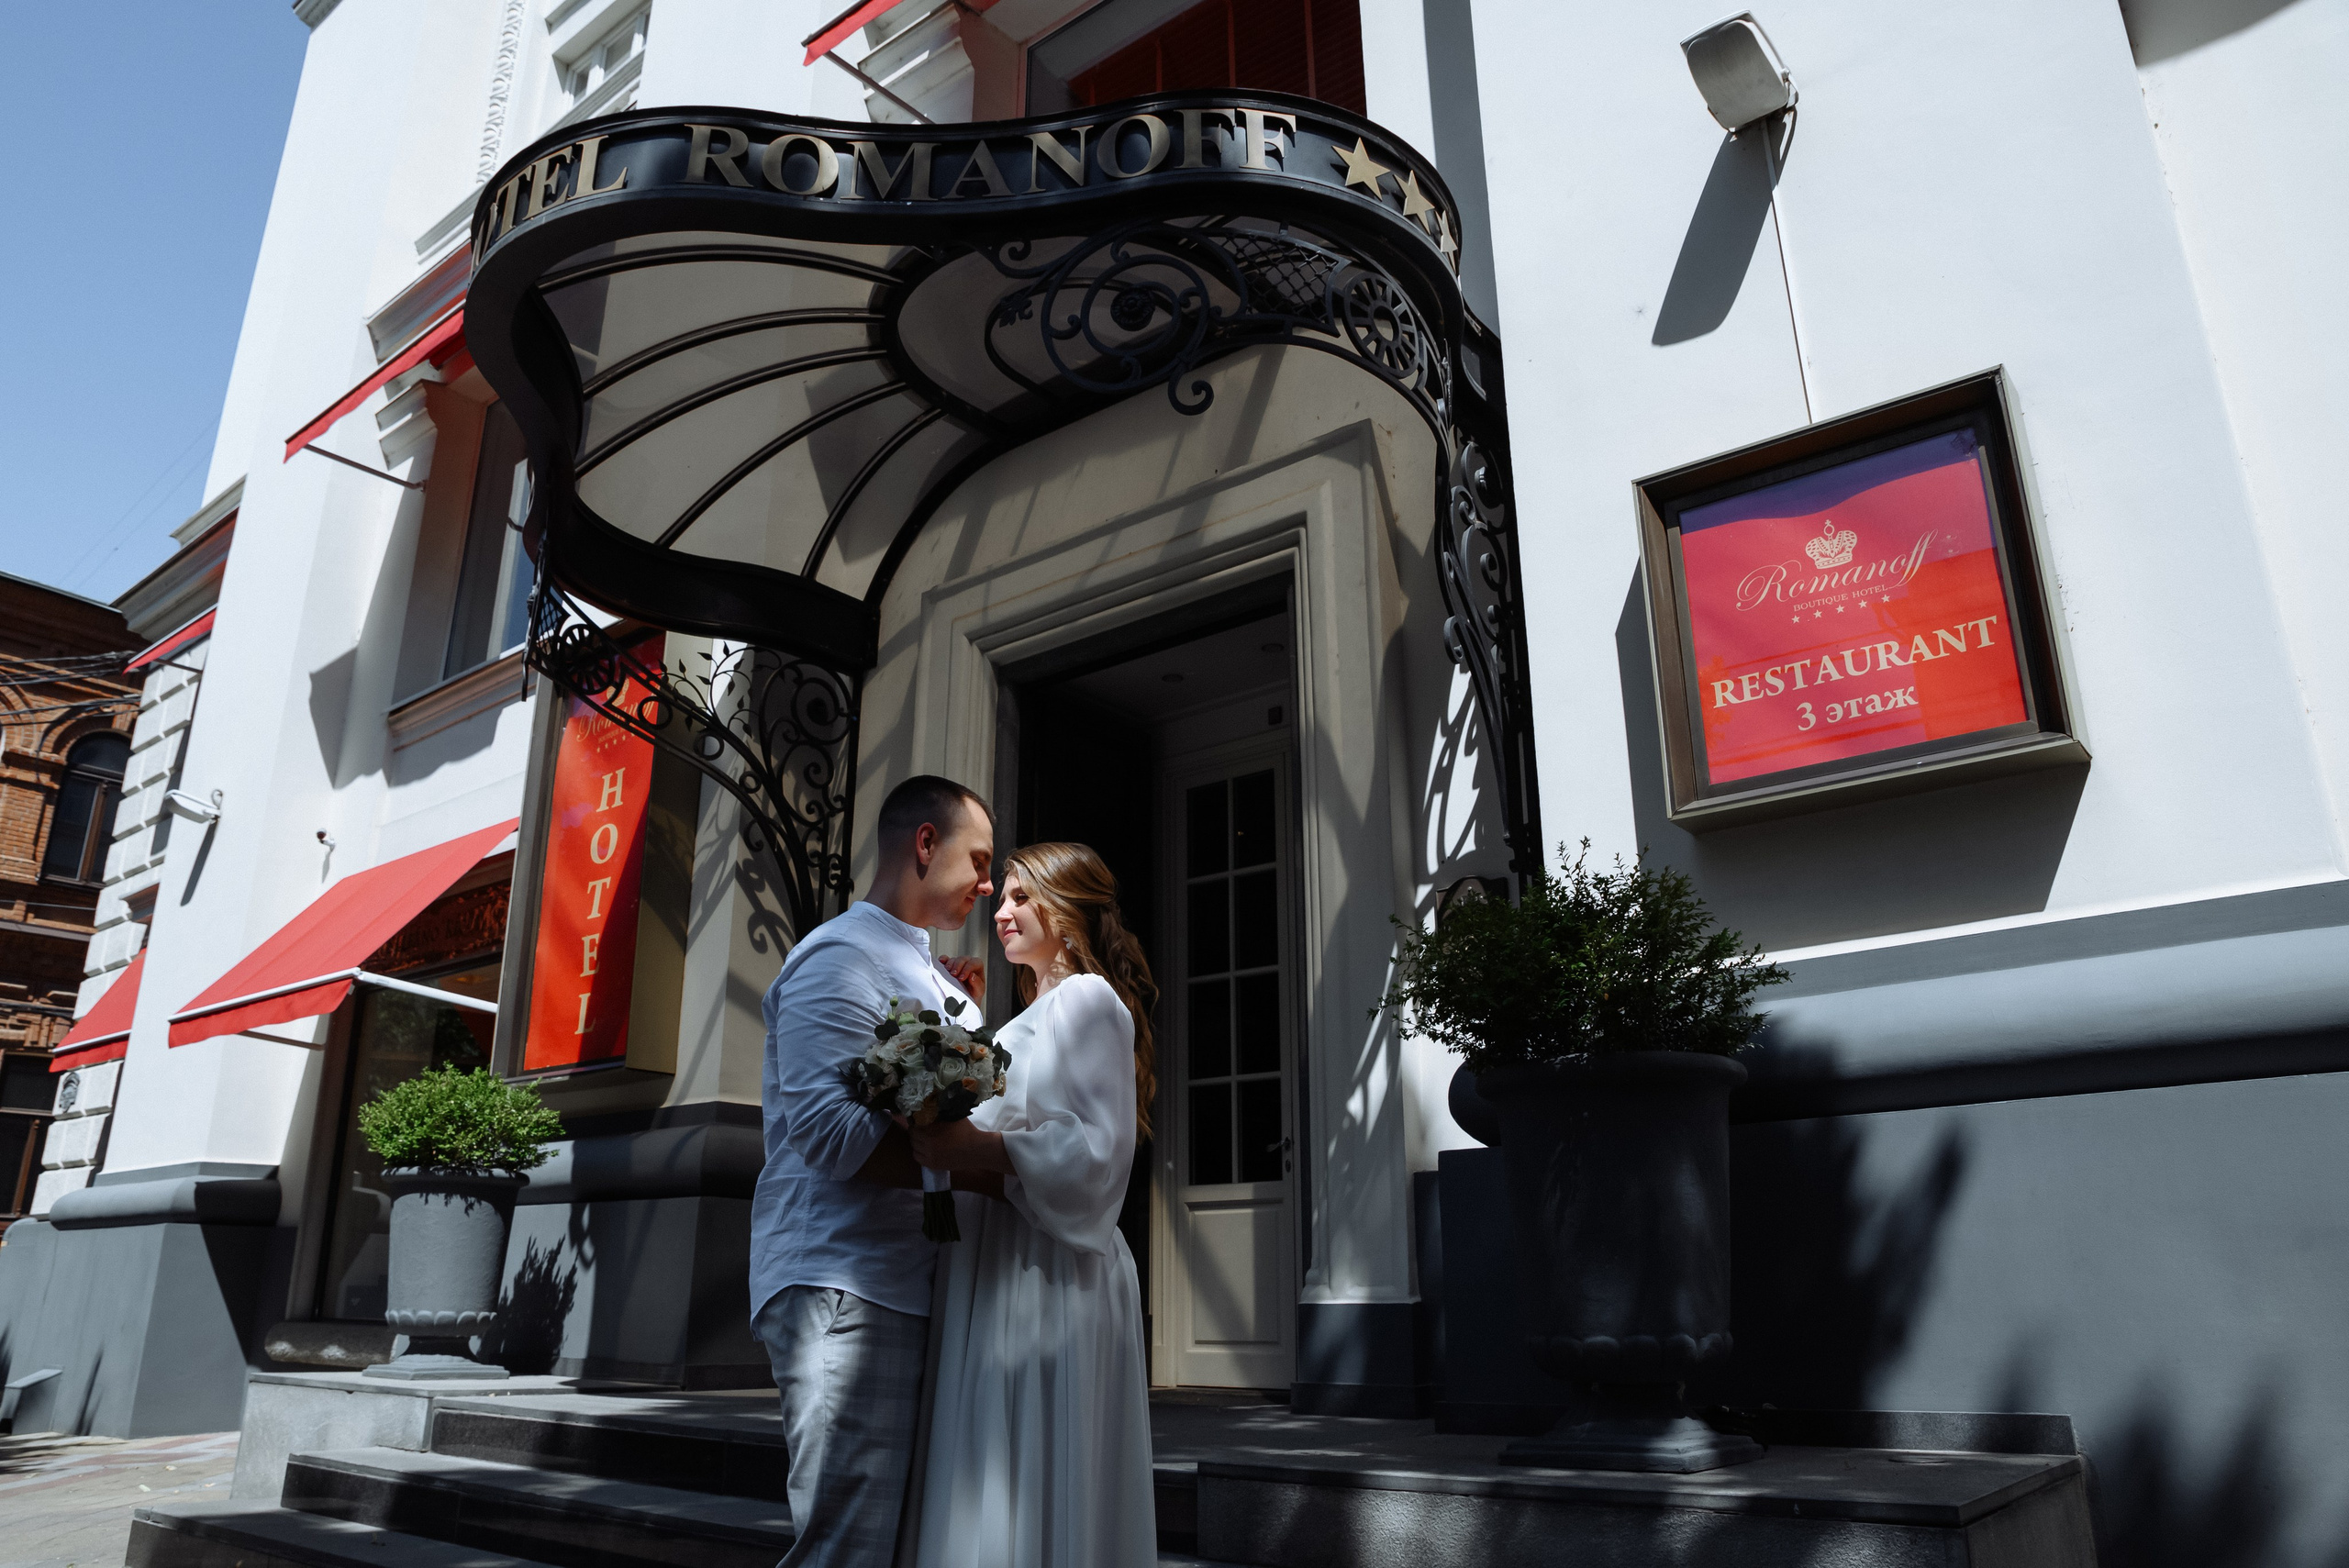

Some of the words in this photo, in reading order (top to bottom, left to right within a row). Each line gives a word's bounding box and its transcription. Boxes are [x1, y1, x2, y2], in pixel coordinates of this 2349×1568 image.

[677, 107, 1297, 201] ROMANOFF
[1735, 528, 1939, 612] Romanoff
[1793, 593, 1849, 612] BOUTIQUE
[1852, 584, 1888, 599] HOTEL
[1710, 615, 1998, 708] RESTAURANT
[1796, 702, 1818, 731] 3
[1825, 685, 1919, 724] этаж
[573, 767, 627, 1035] HOTEL
